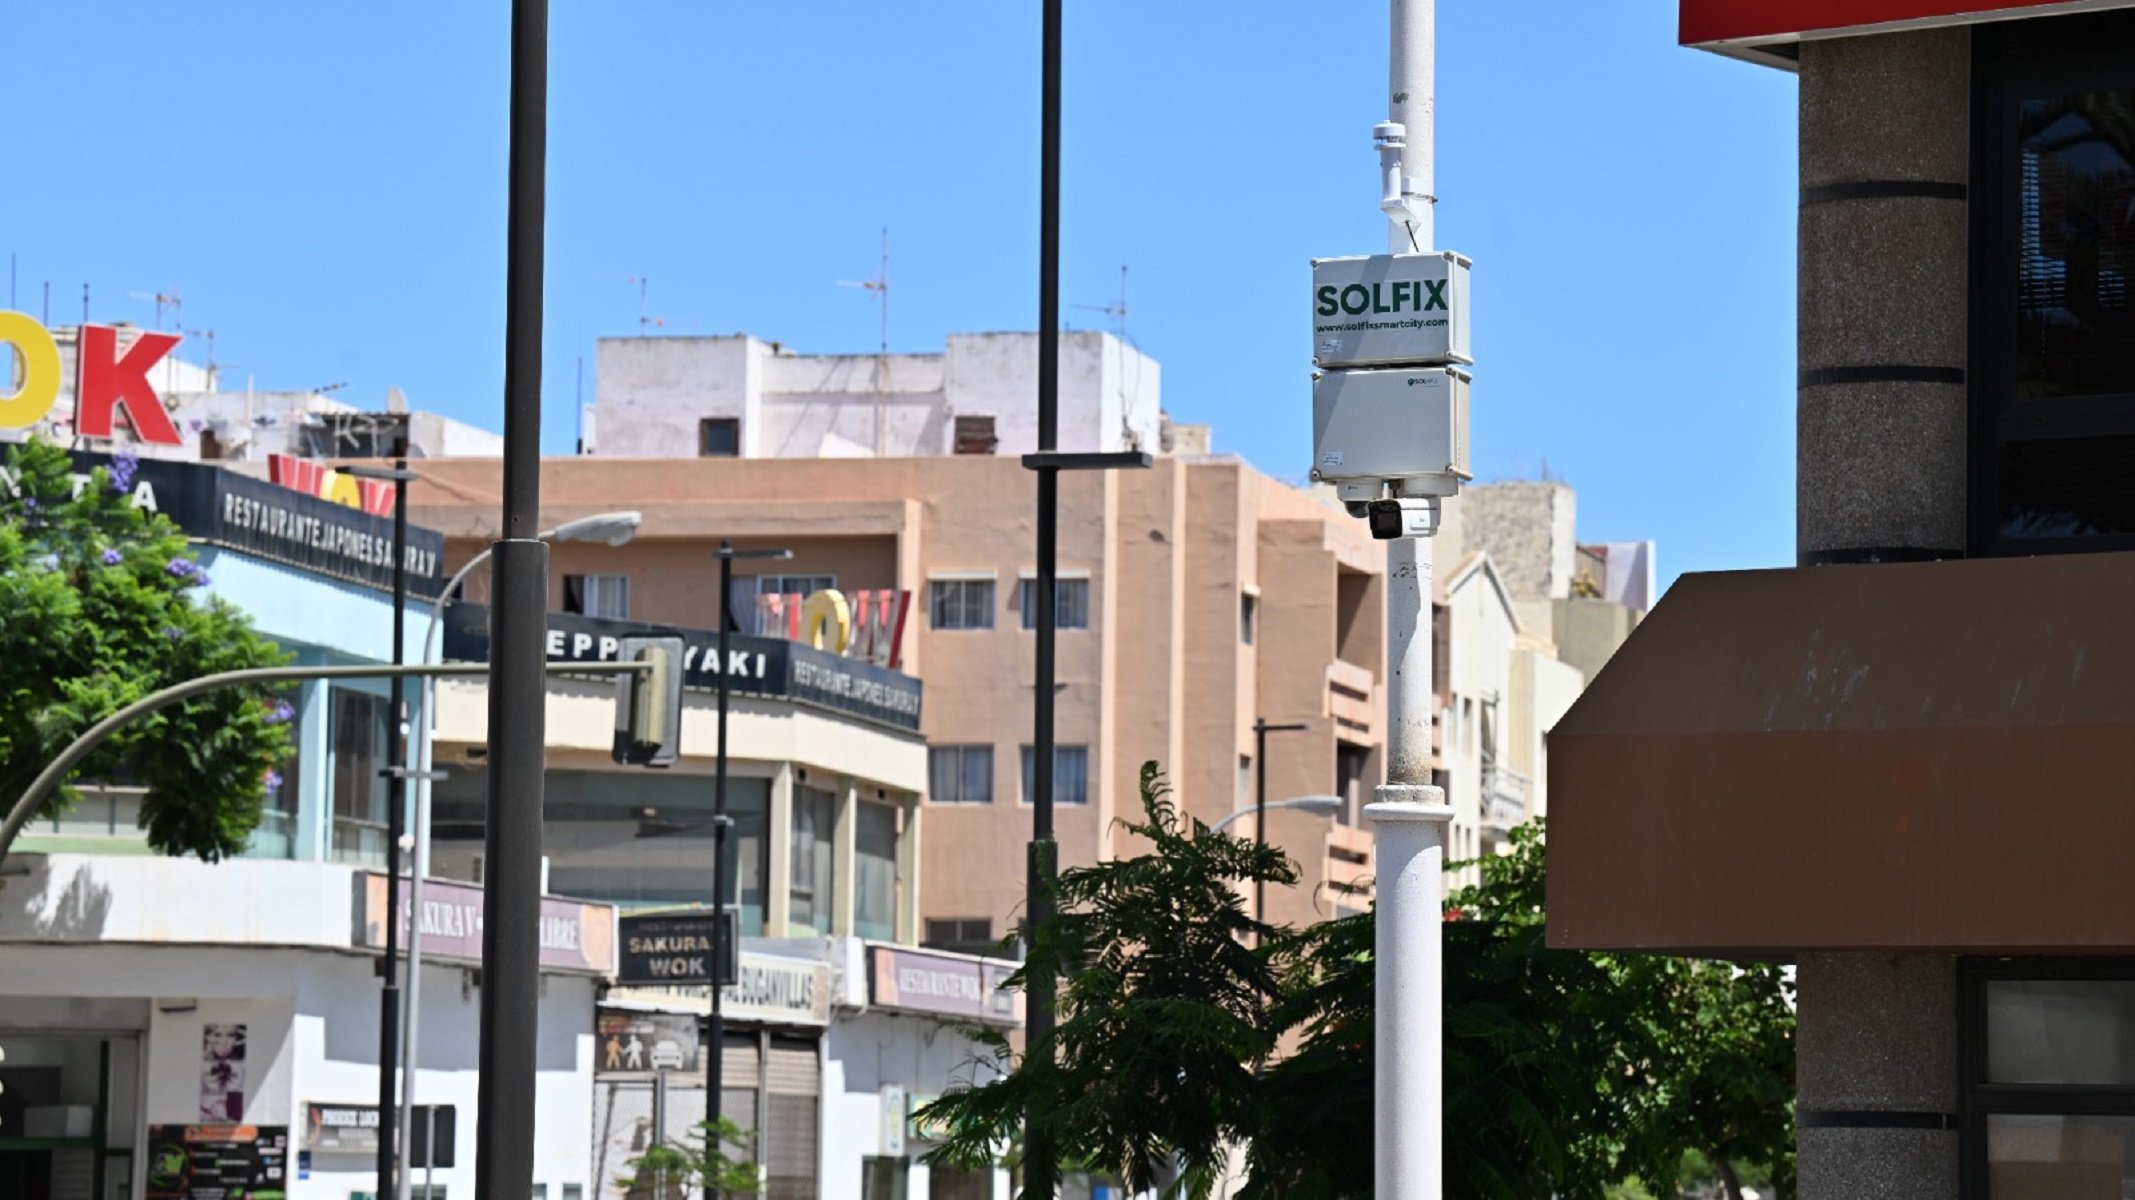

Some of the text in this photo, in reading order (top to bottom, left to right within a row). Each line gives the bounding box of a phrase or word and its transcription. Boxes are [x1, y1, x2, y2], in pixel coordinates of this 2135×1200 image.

[1317, 279, 1448, 316] SOLFIX
[1317, 318, 1448, 333] www.solfixsmartcity.com
[224, 492, 320, 548] RESTAURANTE
[628, 935, 712, 953] SAKURA
[648, 956, 706, 977] WOK
